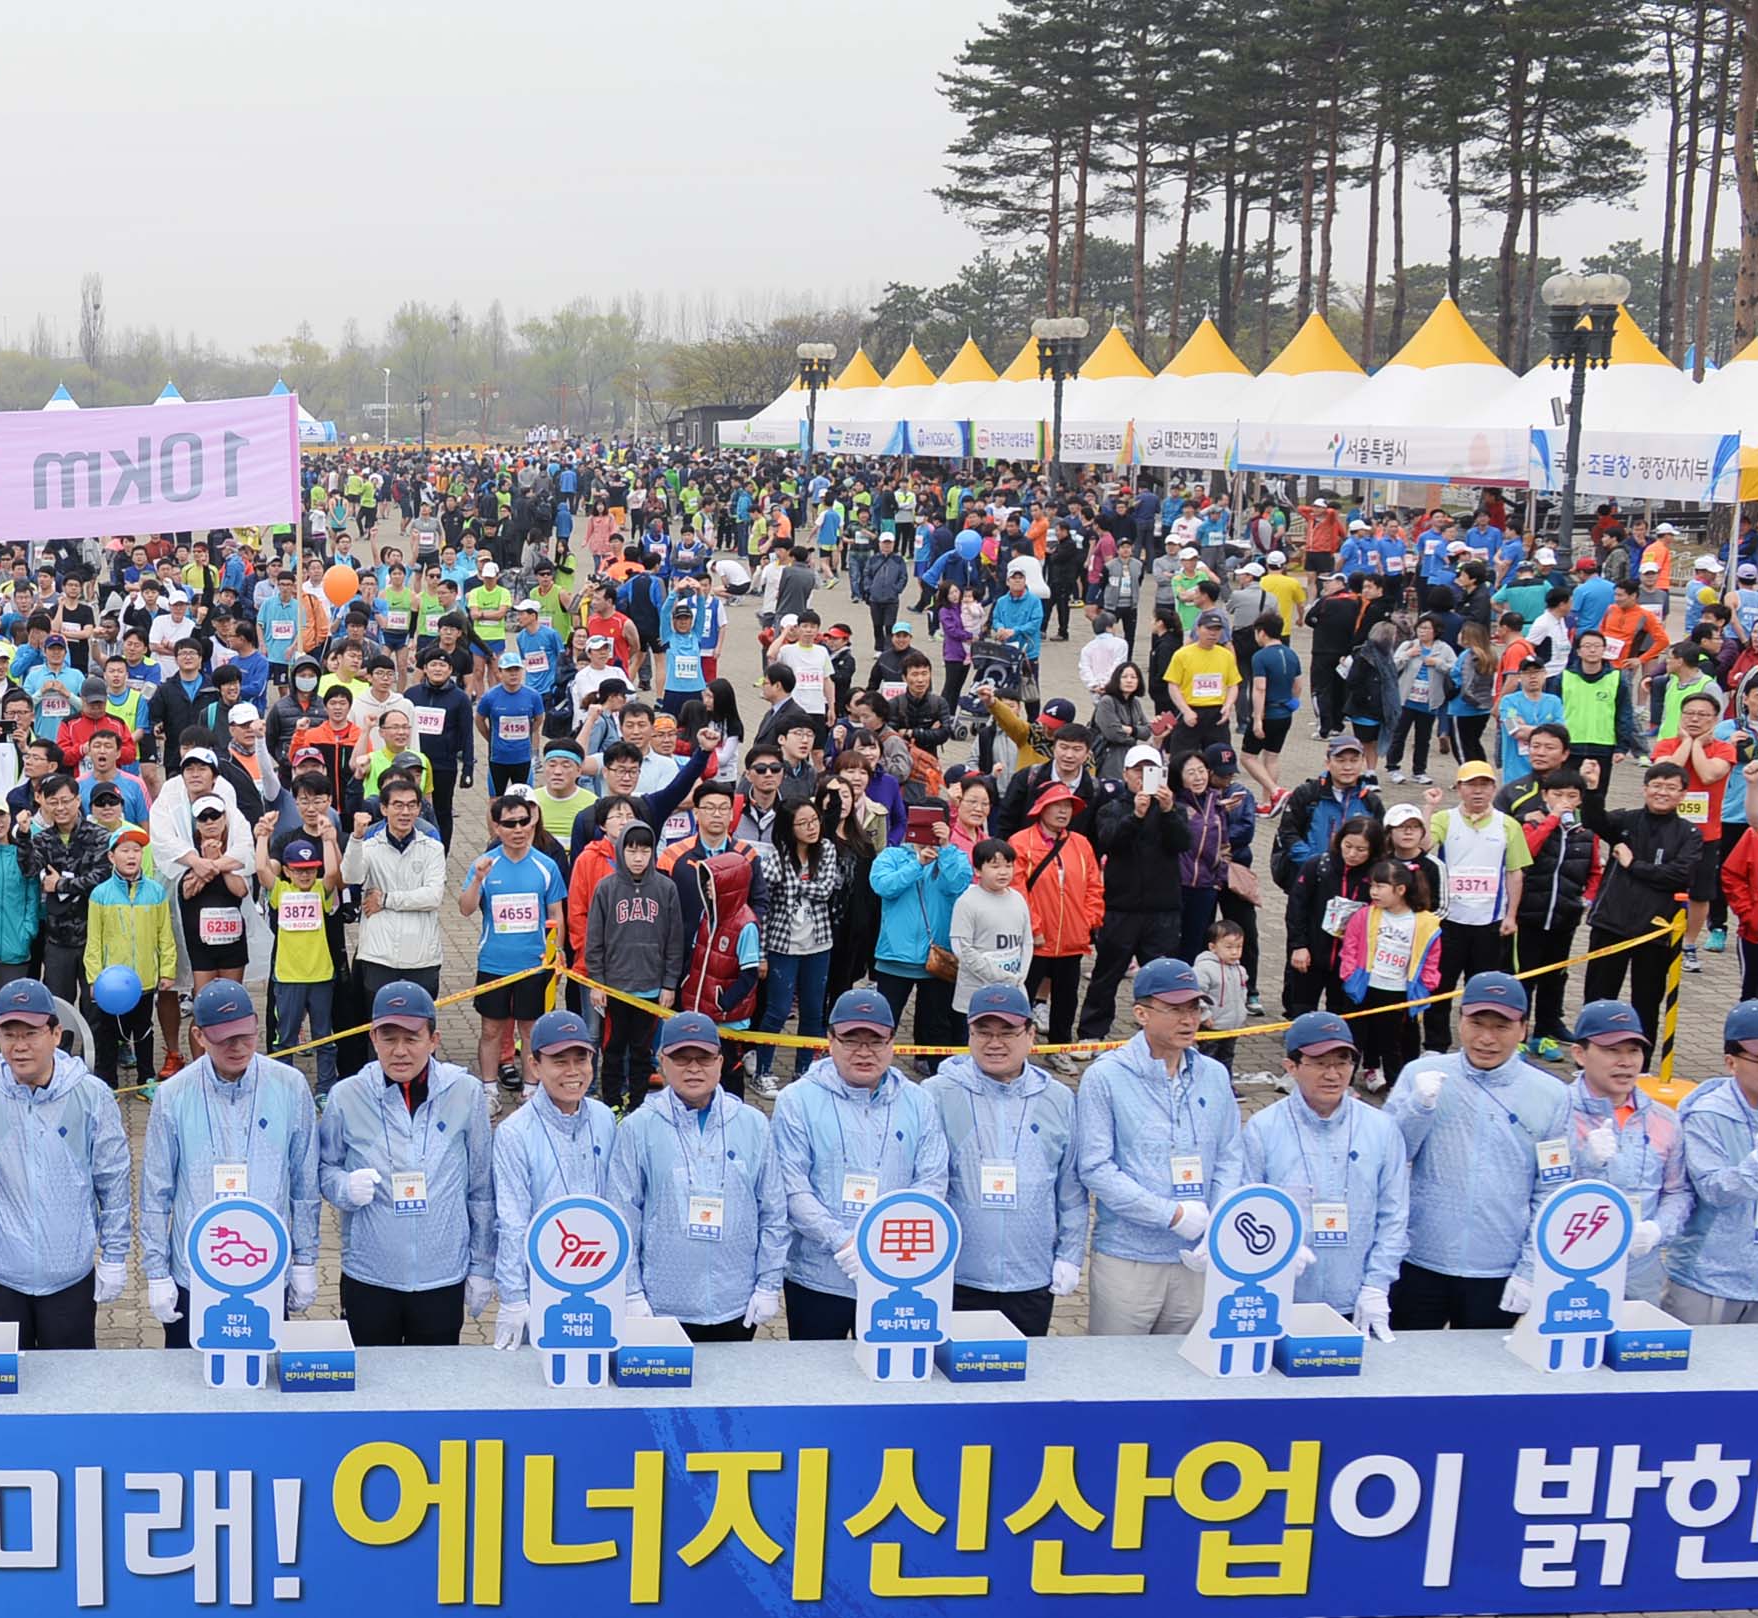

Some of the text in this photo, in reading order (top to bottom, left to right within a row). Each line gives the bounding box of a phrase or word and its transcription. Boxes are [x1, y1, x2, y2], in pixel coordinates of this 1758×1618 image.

[1165, 431, 1218, 450] 대한전기협회
[1346, 436, 1408, 466] 서울특별시
[1678, 803, 1701, 814] 059
[1455, 879, 1489, 891] 3371
[283, 905, 315, 918] 3872
[498, 906, 532, 920] 4655
[616, 897, 659, 924] GAP
[206, 920, 237, 932] 6238
[1376, 949, 1407, 968] 5196
[1569, 1297, 1589, 1308] ESS
[561, 1312, 594, 1325] 에너지
[893, 1306, 915, 1318] 제로
[226, 1313, 248, 1326] 전기
[876, 1317, 931, 1331] 에너지 빌딩
[221, 1325, 253, 1338] 자동차
[561, 1324, 594, 1338] 자립섬
[332, 1439, 1465, 1606] 에너지신산업이
